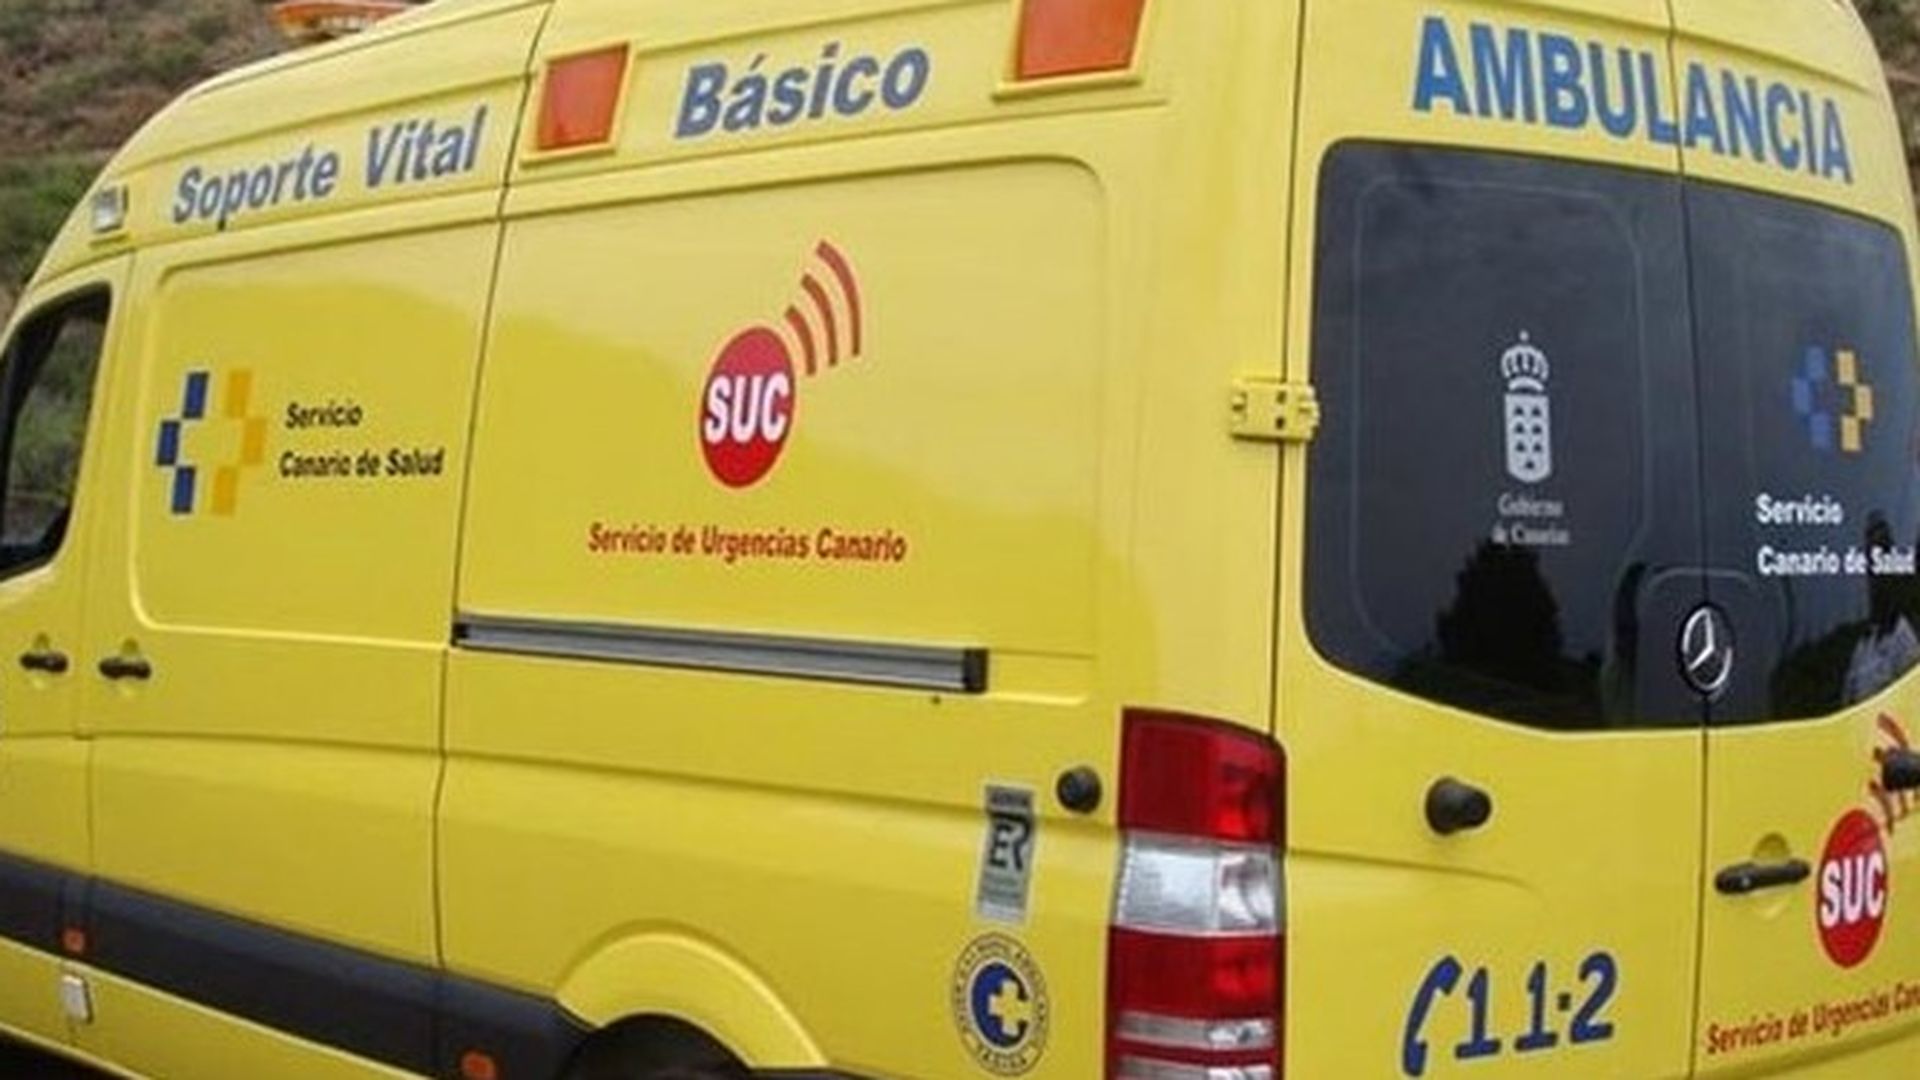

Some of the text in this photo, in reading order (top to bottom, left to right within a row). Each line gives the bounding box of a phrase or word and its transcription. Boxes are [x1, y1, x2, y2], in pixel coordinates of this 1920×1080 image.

[1412, 16, 1854, 185] AMBULANCIA
[172, 43, 931, 231] Soporte Vital Básico
[285, 400, 364, 430] Servicio
[704, 374, 790, 445] SUC
[279, 447, 446, 478] Canario de Salud
[1757, 493, 1843, 526] Servicio
[587, 523, 908, 564] Servicio de Urgencias Canario
[1757, 545, 1916, 575] Canario de Salud
[1820, 851, 1886, 927] SUC
[1707, 1013, 1783, 1054] Servicio
[1787, 1010, 1810, 1038] de
